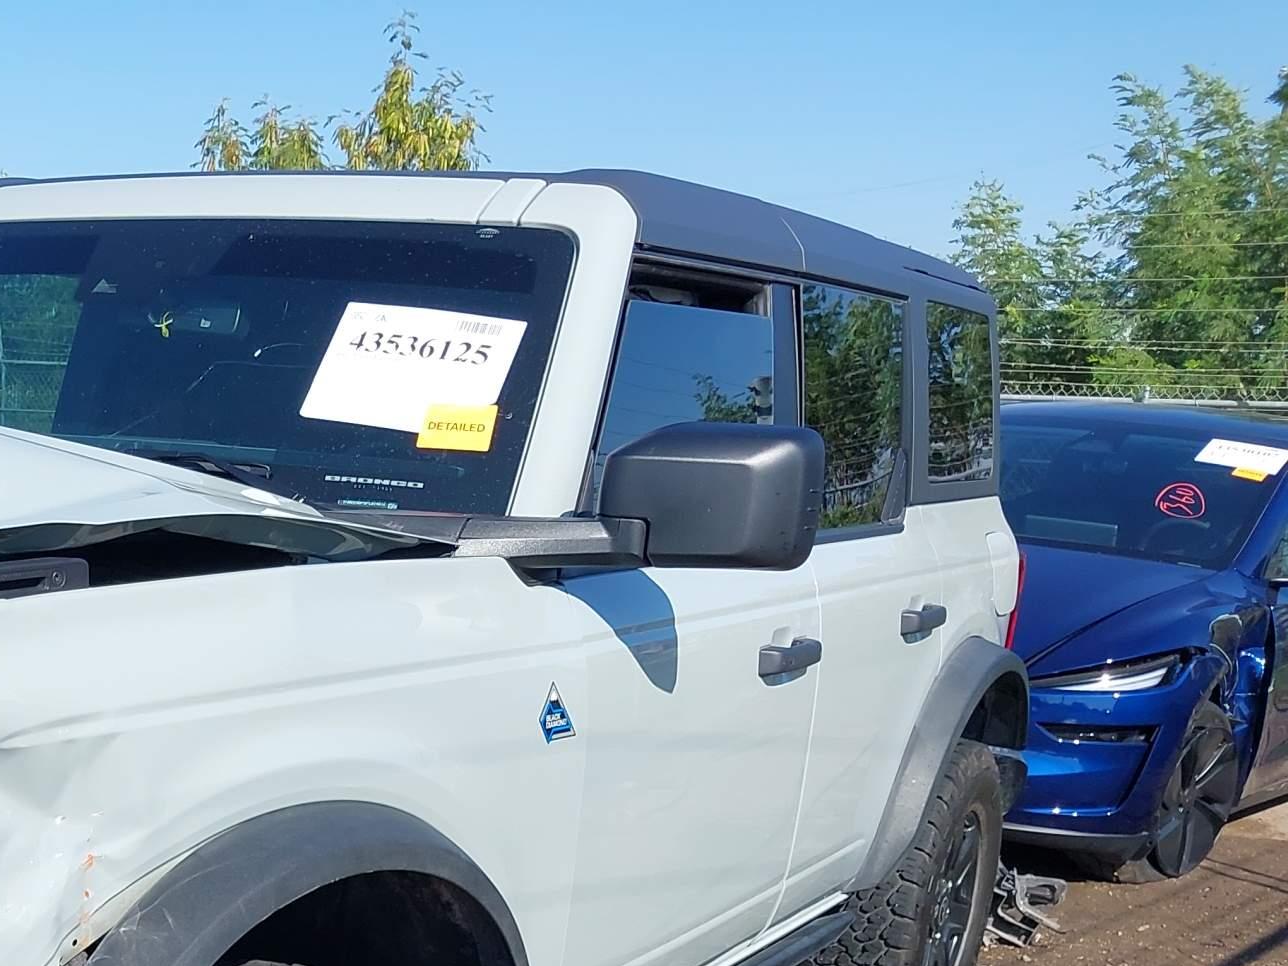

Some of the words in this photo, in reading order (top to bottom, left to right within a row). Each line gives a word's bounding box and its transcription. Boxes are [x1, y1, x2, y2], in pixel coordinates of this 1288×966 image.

[349, 330, 492, 365] 43536125
[427, 421, 486, 433] DETAILED
[324, 474, 424, 488] BRONCO
